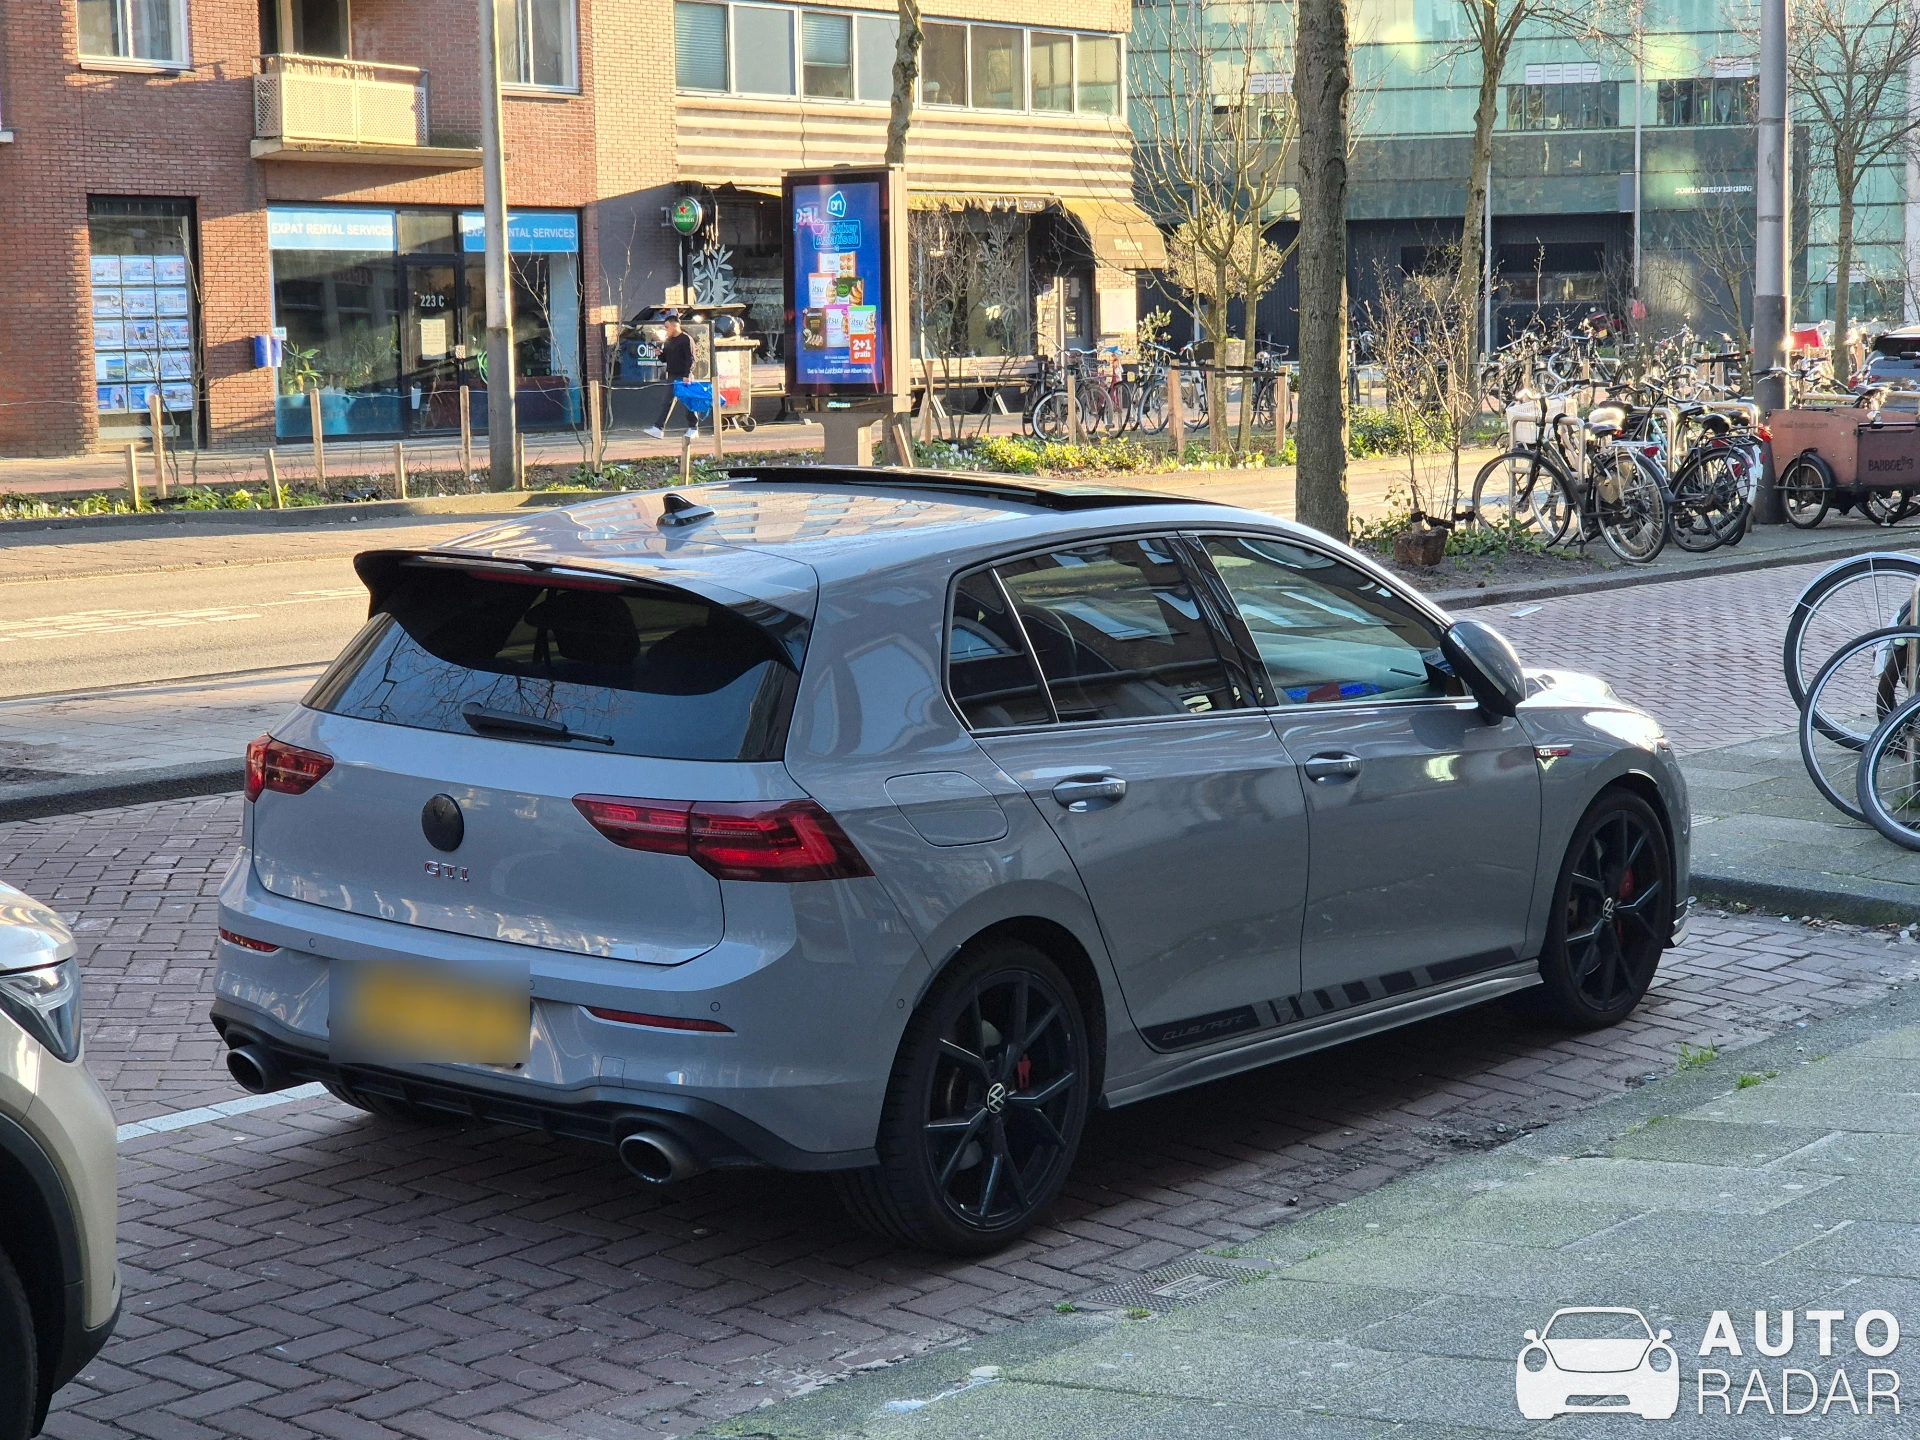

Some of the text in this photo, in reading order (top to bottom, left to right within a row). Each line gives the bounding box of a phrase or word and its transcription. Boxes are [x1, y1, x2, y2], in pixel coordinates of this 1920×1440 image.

[271, 223, 394, 237] EXPAT RENTAL SERVICES
[508, 227, 531, 238] NTAL
[533, 228, 575, 238] SERVICES
[811, 285, 825, 294] itsu
[420, 294, 445, 308] 223 C
[850, 318, 864, 326] itsu
[852, 338, 872, 351] 2+1
[853, 350, 871, 360] gratis
[1868, 459, 1903, 471] BABBOE
[1539, 748, 1552, 756] GTI
[424, 860, 469, 882] GTI
